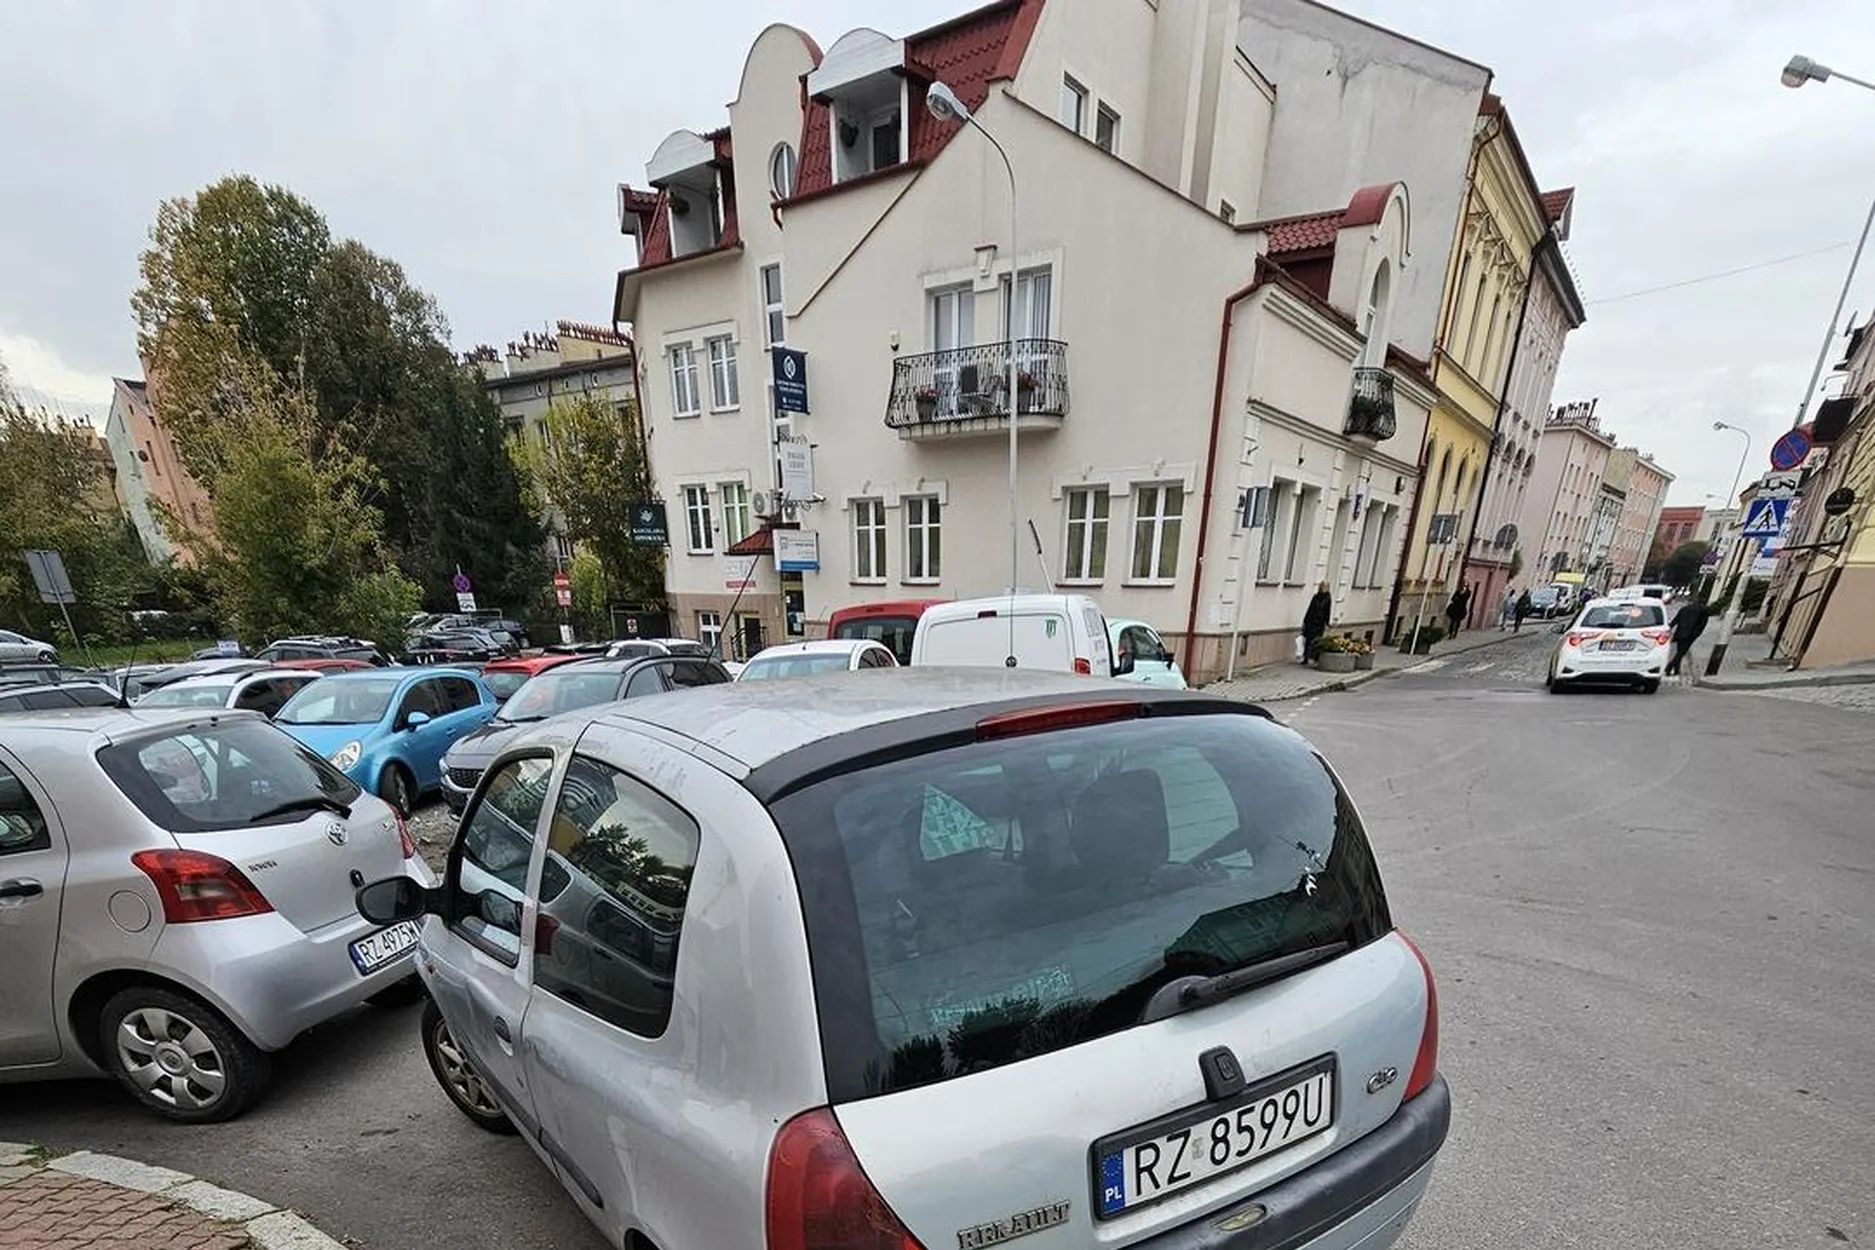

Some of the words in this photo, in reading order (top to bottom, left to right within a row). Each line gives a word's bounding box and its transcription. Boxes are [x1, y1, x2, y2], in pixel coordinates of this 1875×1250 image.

[359, 939, 383, 964] RZ
[1134, 1128, 1192, 1196] RZ
[1209, 1077, 1324, 1166] 8599U
[1105, 1186, 1123, 1202] PL
